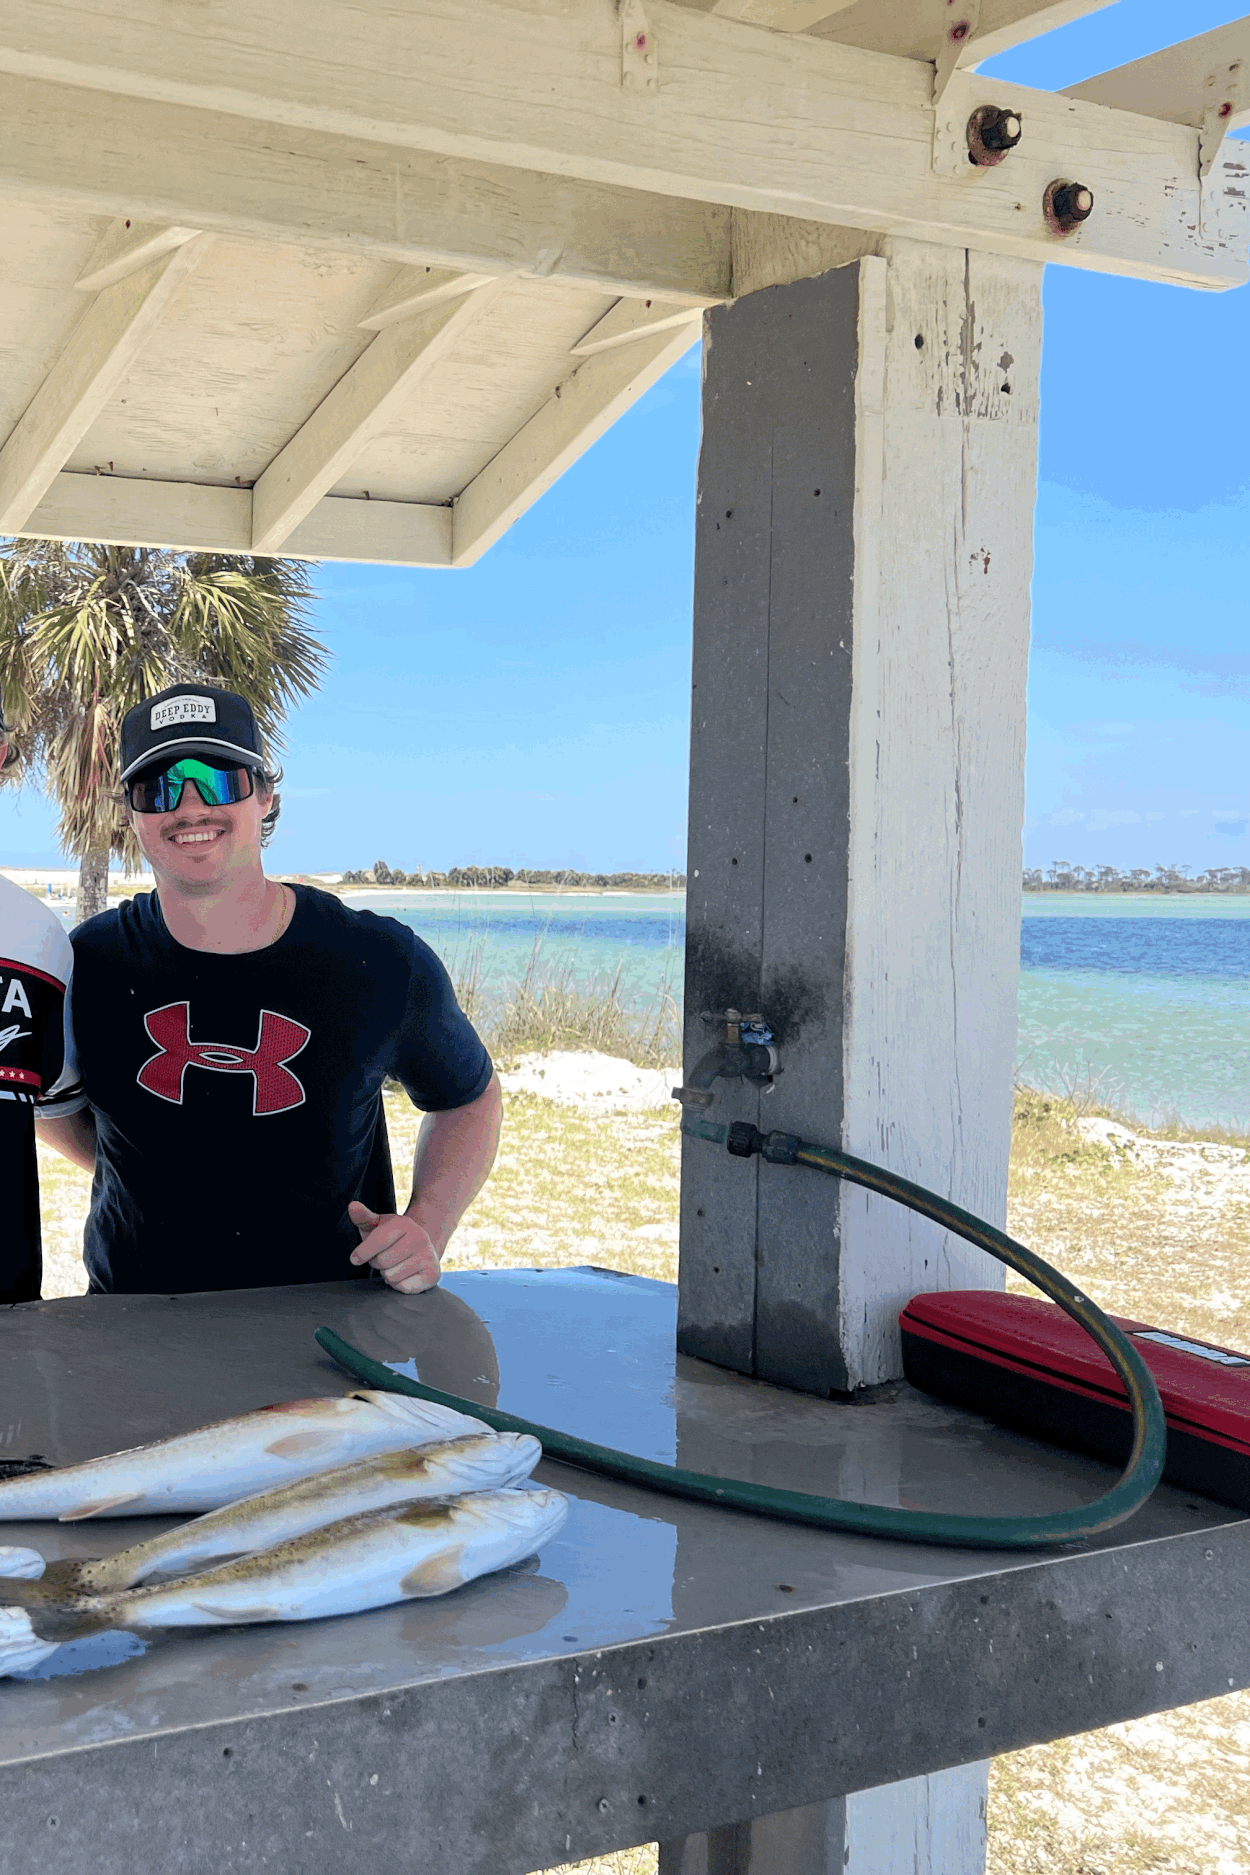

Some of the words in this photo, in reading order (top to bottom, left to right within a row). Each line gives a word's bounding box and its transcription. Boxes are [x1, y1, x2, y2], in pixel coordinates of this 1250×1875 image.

[155, 705, 180, 721] DEEP
[183, 703, 210, 713] EDDY
[159, 714, 207, 724] VODKA
